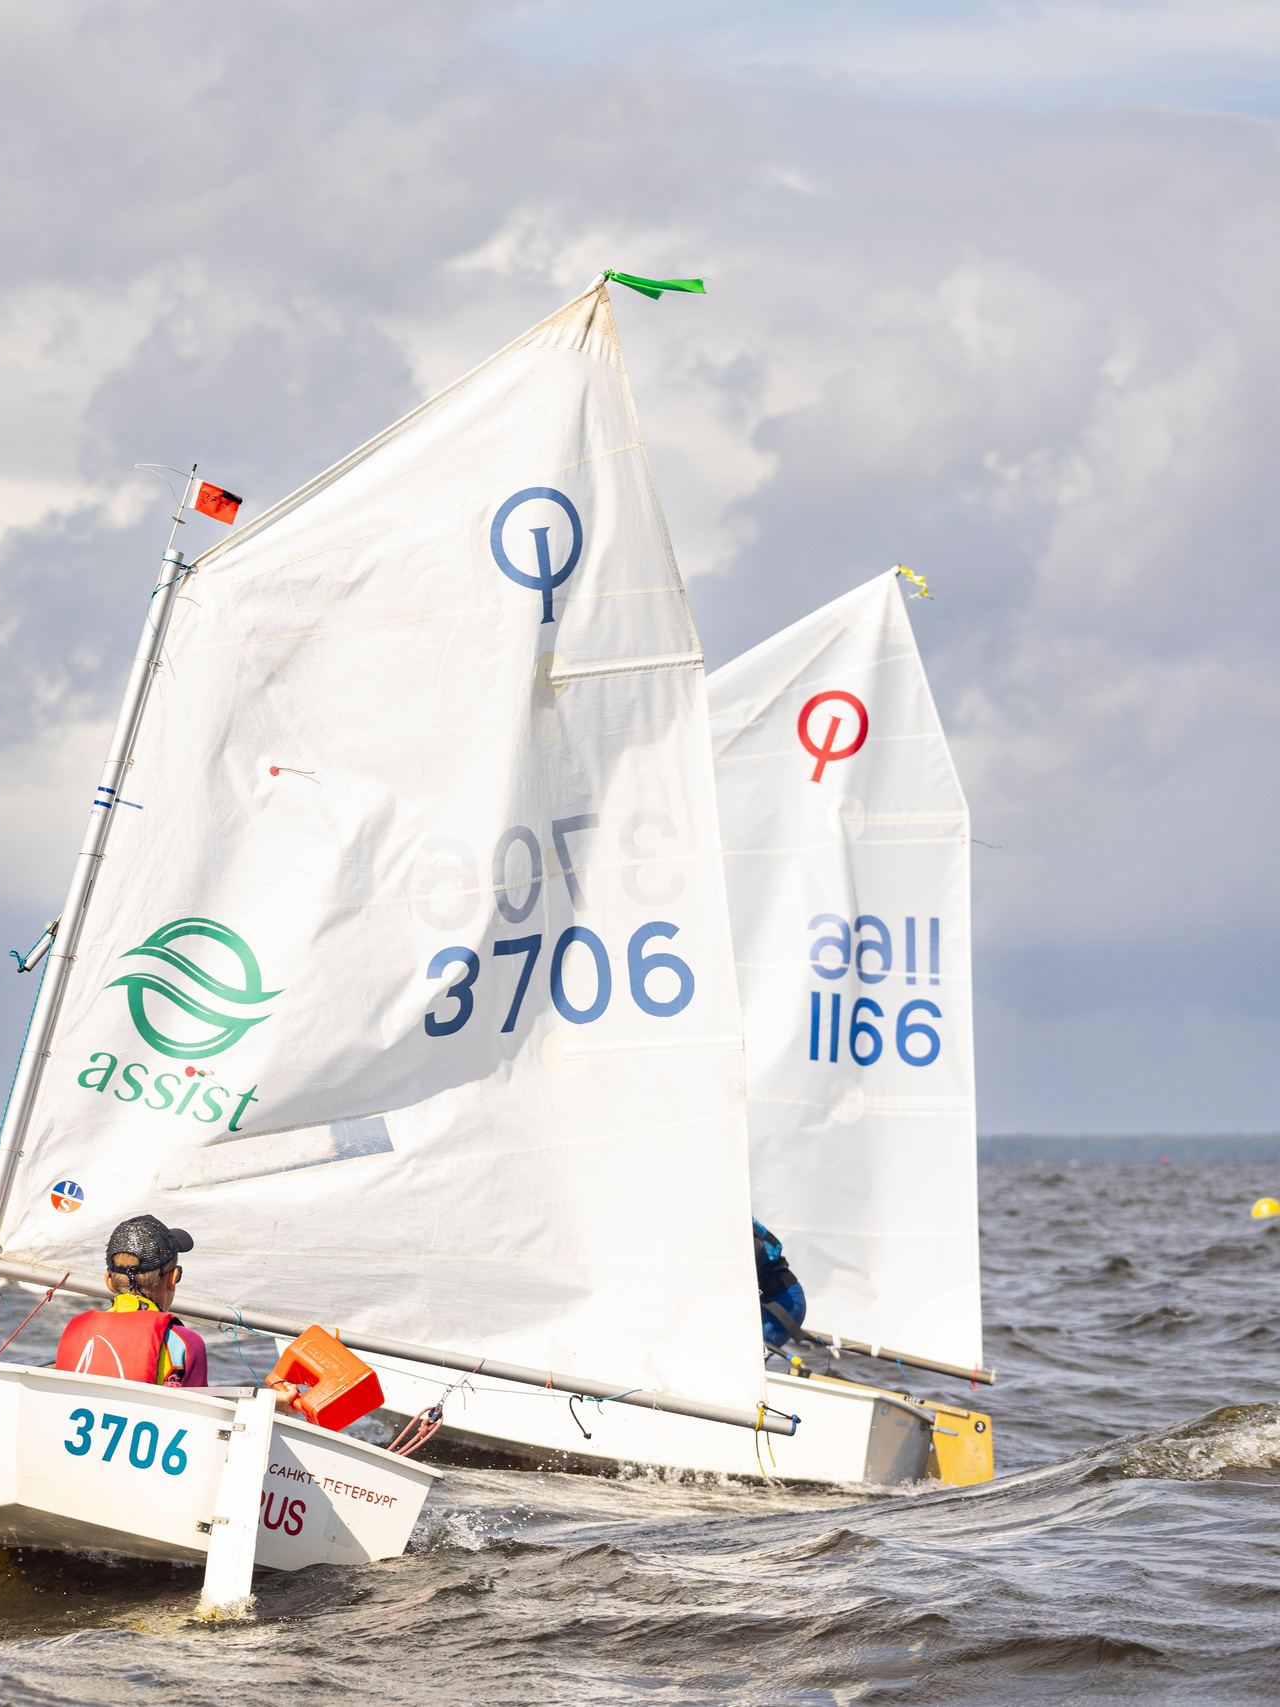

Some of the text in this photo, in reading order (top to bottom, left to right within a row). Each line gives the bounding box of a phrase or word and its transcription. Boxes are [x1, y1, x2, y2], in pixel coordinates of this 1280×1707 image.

[424, 921, 695, 1037] 3706
[809, 991, 942, 1067] 1166
[78, 1052, 259, 1132] assist
[57, 1198, 73, 1213] S
[63, 1181, 79, 1197] U
[64, 1408, 188, 1476] 3706
[258, 1490, 306, 1536] US
[269, 1463, 397, 1508] САНКТ-ПЕТЕРБУРГ
